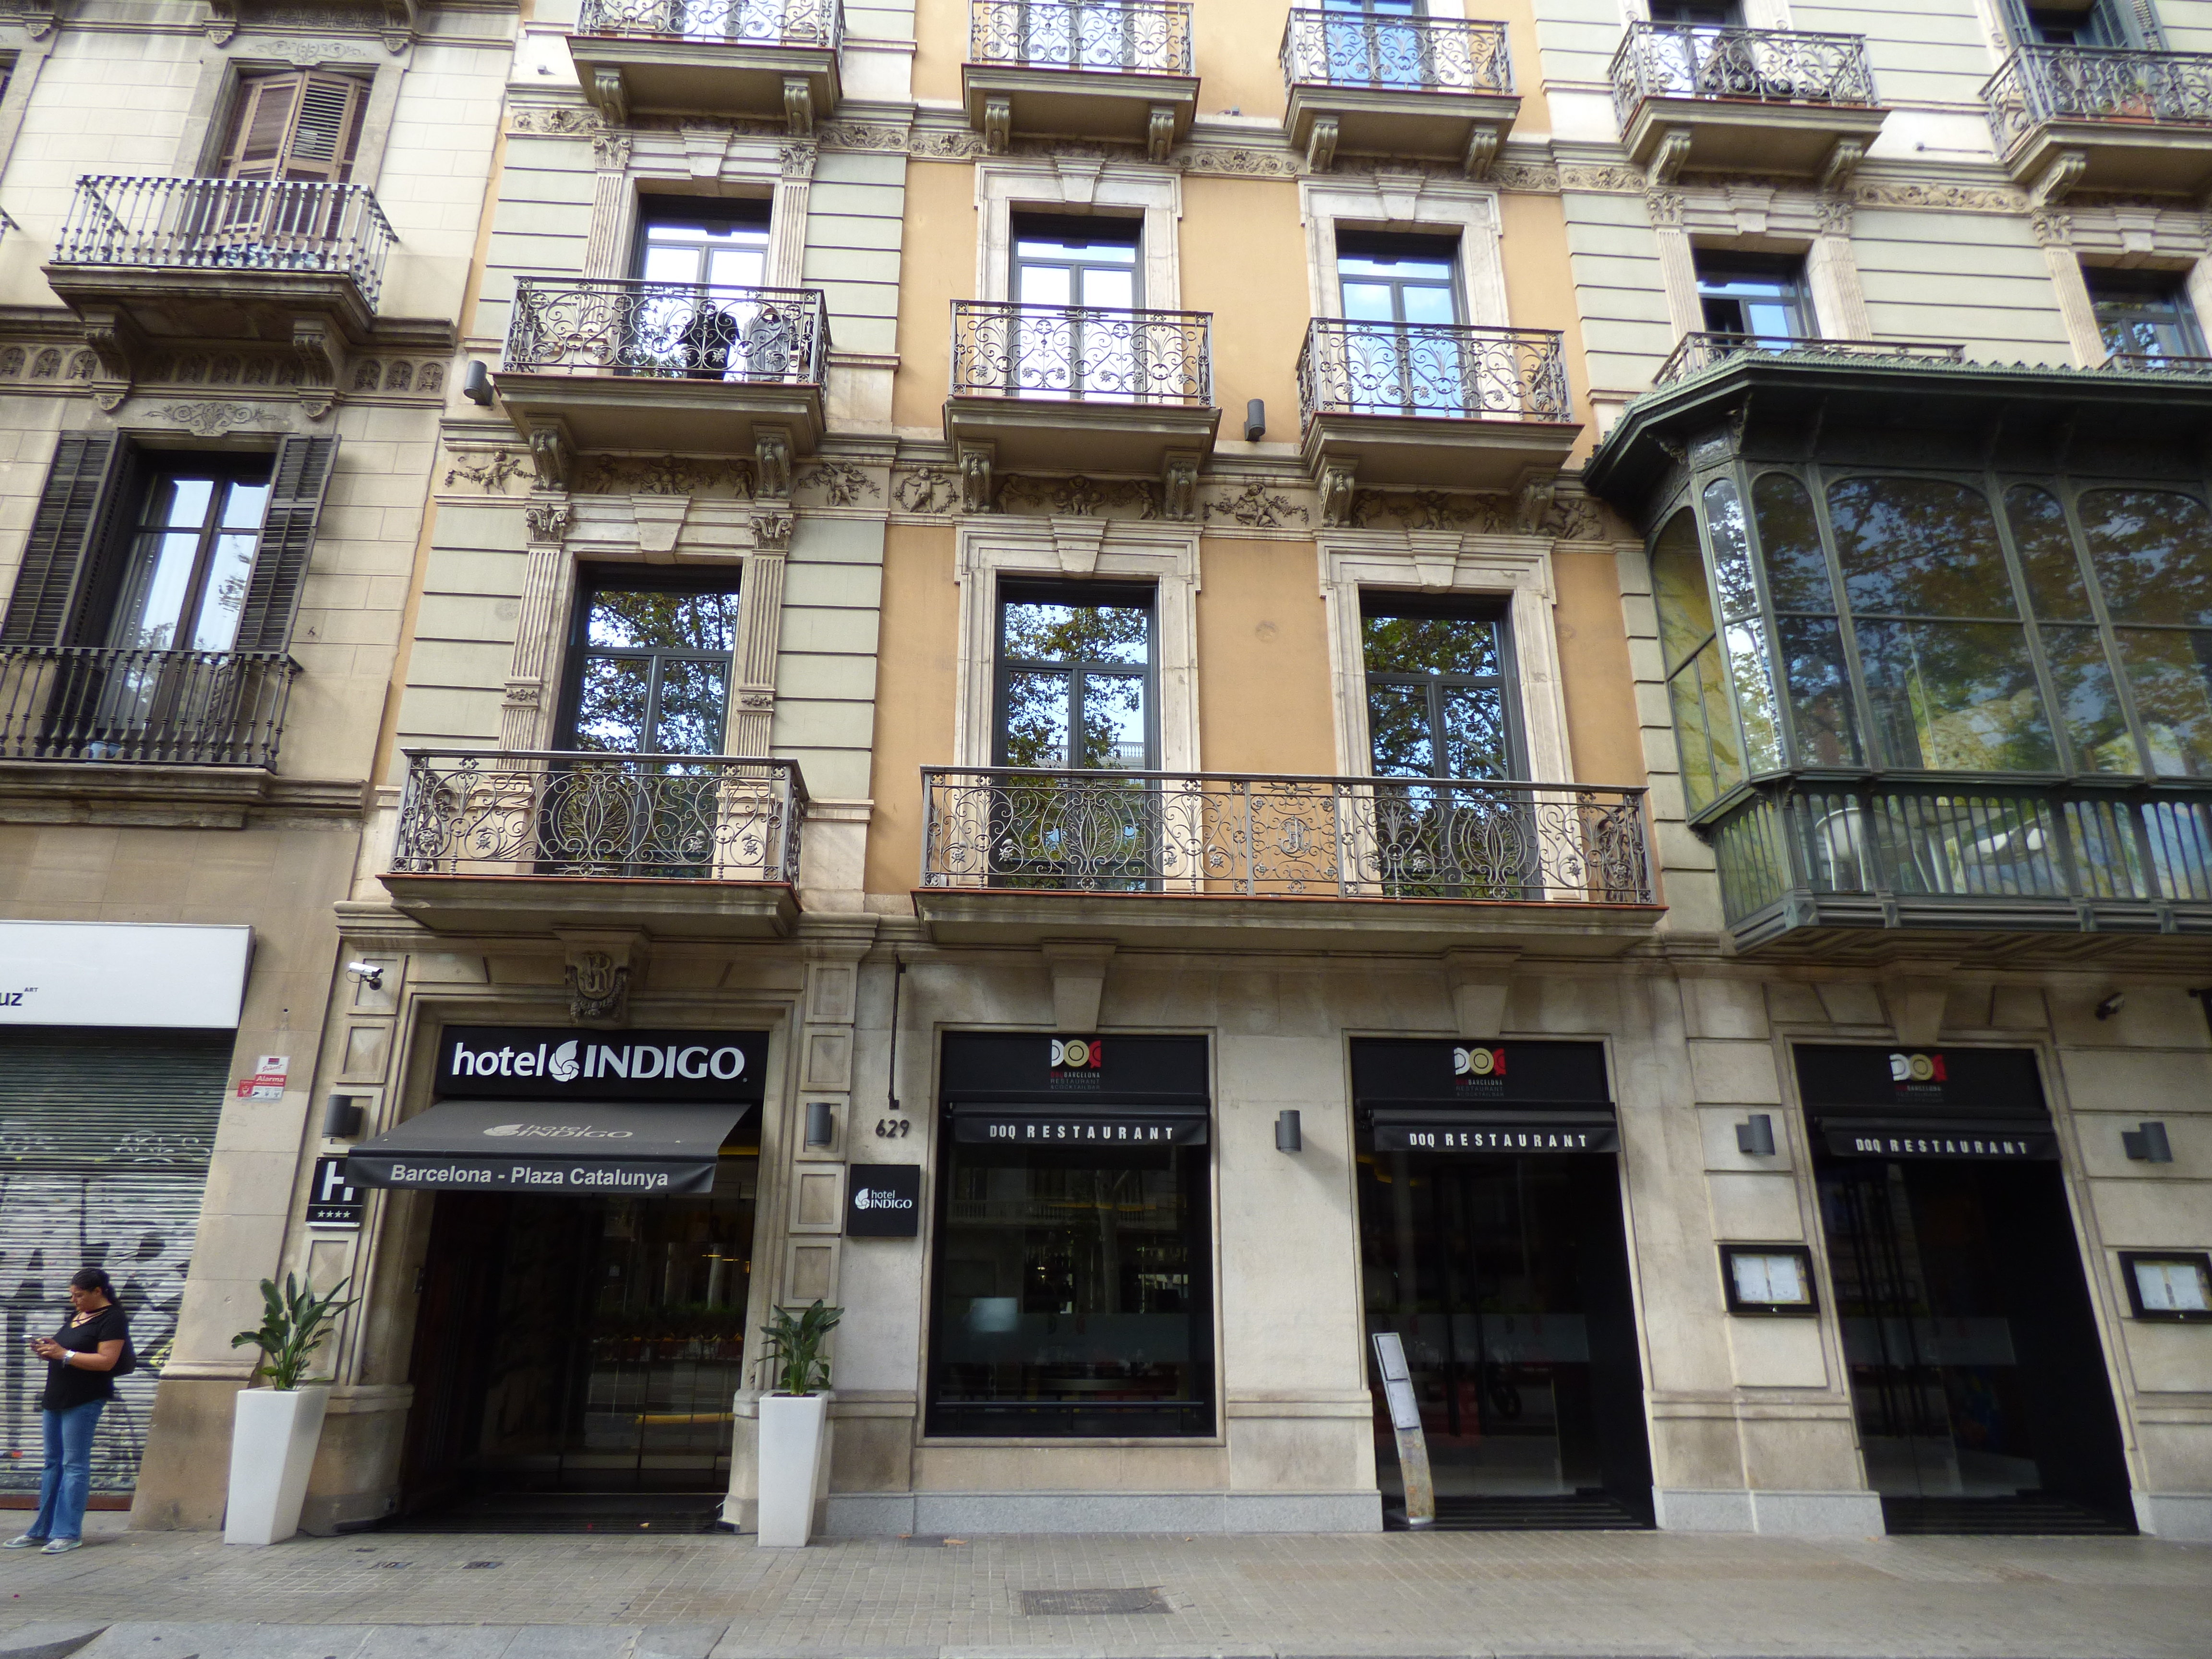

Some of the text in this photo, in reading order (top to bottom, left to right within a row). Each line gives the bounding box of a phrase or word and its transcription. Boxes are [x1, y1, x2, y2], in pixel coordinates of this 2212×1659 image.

[452, 1042, 745, 1080] hotel INDIGO
[875, 1119, 910, 1138] 629
[989, 1125, 1173, 1140] DOQ RESTAURANT
[1409, 1133, 1586, 1148] DOQ RESTAURANT
[1855, 1138, 2027, 1154] DOQ RESTAURANT
[390, 1165, 491, 1182] Barcelona
[511, 1167, 564, 1184] Plaza
[570, 1167, 668, 1190] Catalunya
[871, 1190, 895, 1199] hotel
[871, 1199, 913, 1209] INDIGO
